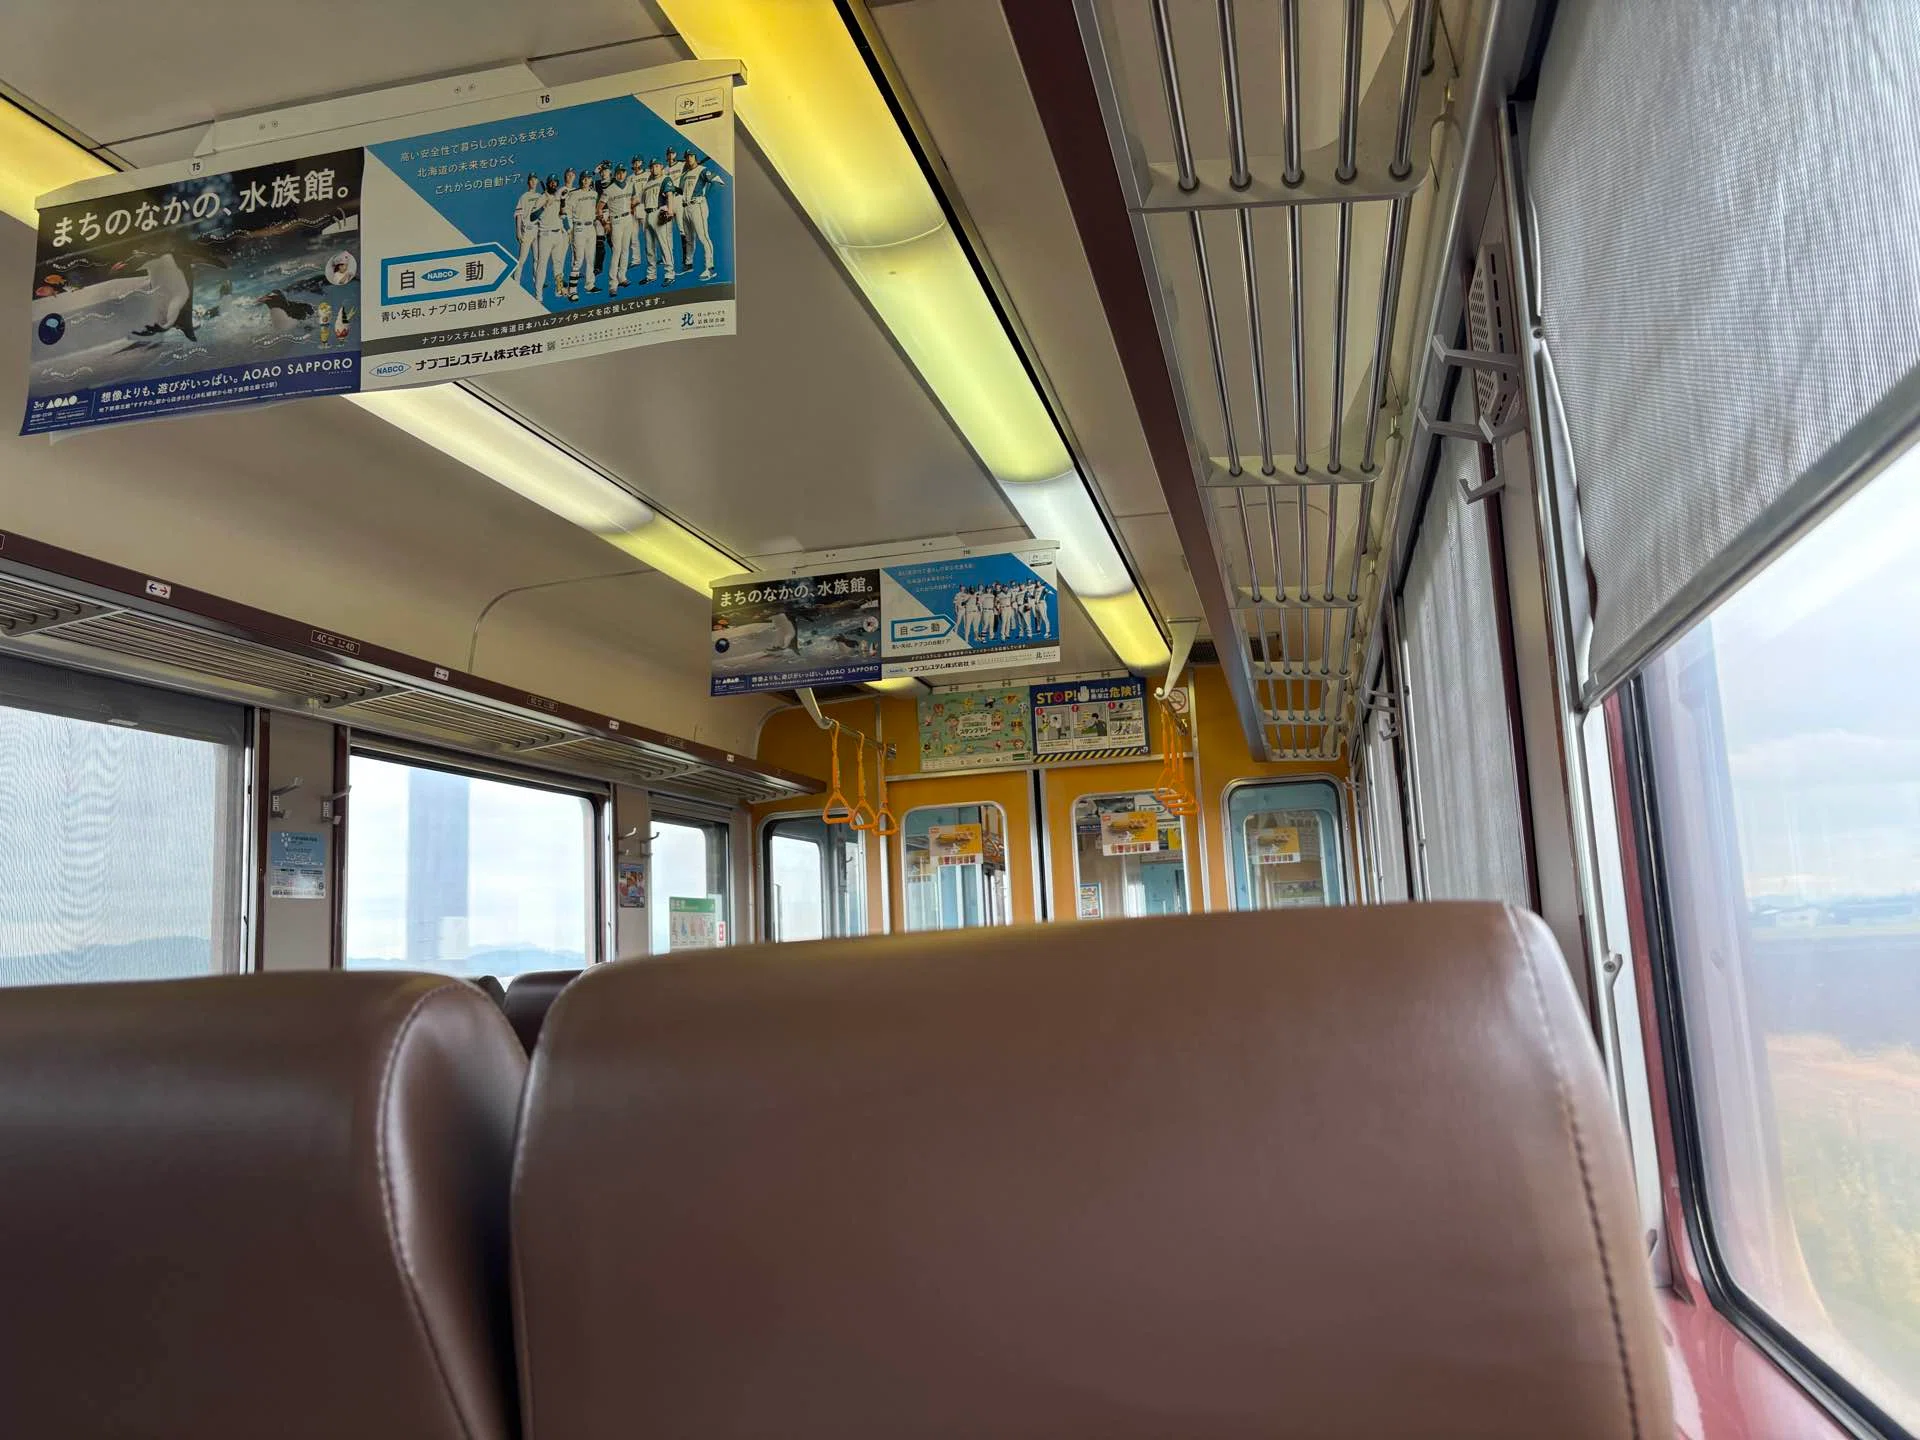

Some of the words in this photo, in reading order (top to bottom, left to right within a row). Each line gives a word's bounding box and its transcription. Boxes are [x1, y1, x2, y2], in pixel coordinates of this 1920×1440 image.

[540, 94, 550, 105] T6
[192, 162, 201, 172] T5
[417, 154, 516, 178] 北海道の未来をひらく
[51, 168, 349, 248] まちのなかの、水族館。
[381, 296, 506, 323] 青い矢印、ナブコの自動ドア
[376, 362, 404, 376] NABCO
[415, 343, 544, 372] ナブコシステム株式会社
[100, 374, 238, 403] 想像よりも、遊びがいっぱい。
[243, 365, 282, 381] AOAO
[287, 358, 353, 375] SAPPORO
[720, 576, 873, 608] まちのなかの、水族館。
[1036, 690, 1078, 705] STOP!
